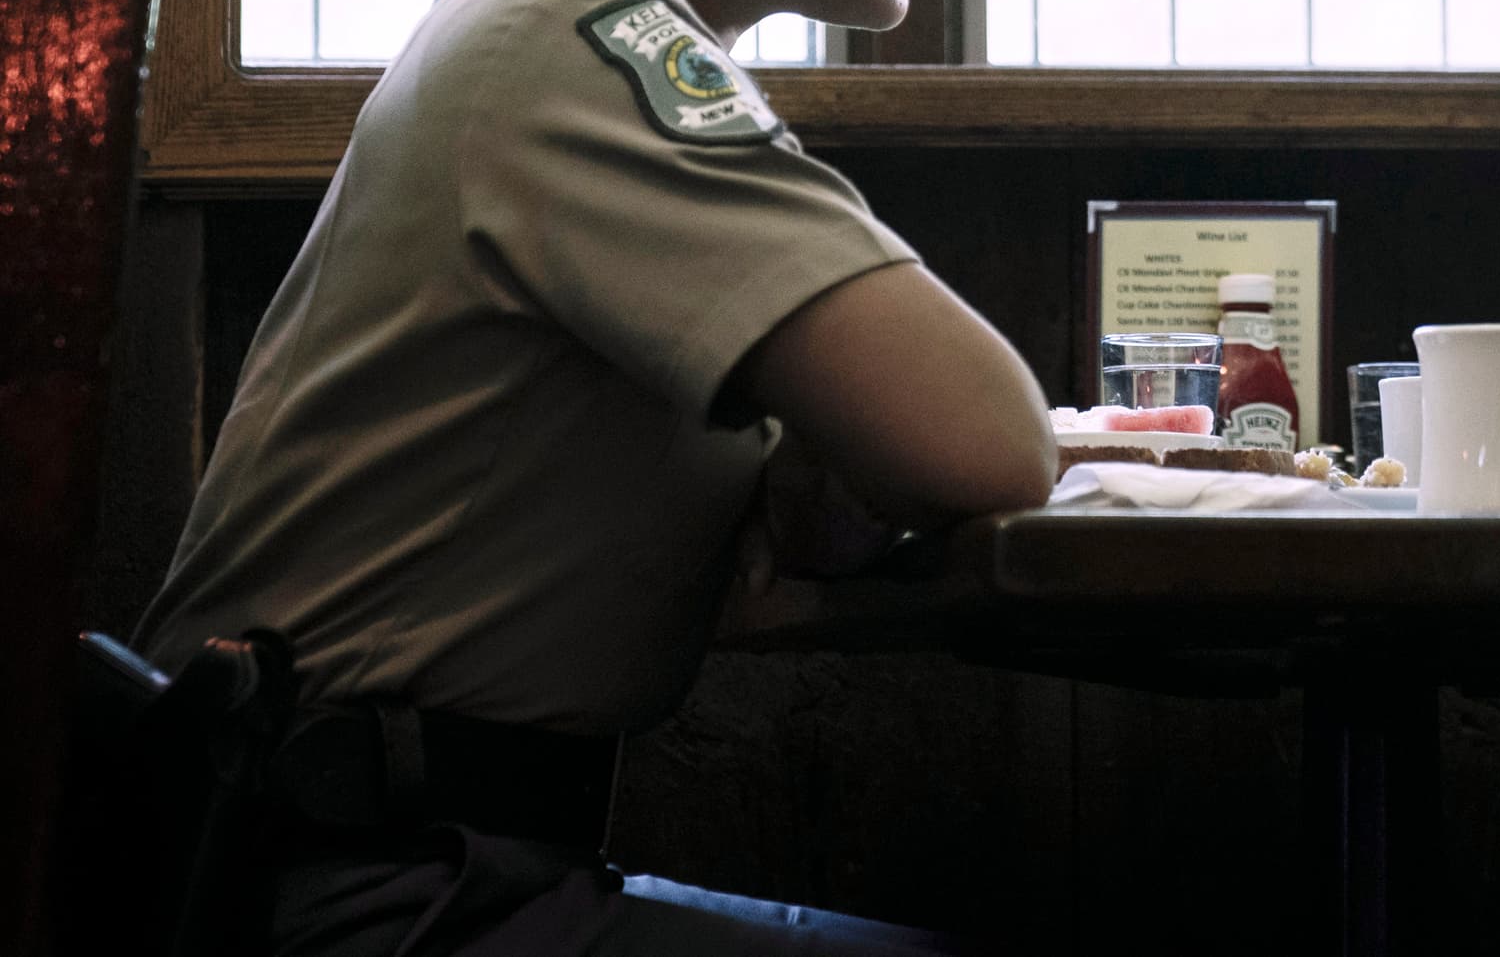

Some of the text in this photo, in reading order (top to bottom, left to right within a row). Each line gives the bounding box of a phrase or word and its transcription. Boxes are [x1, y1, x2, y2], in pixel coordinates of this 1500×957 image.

[700, 103, 735, 123] NEW
[1196, 231, 1247, 242] Wine List
[1117, 301, 1134, 311] Cup
[1137, 300, 1159, 309] Cake
[1246, 416, 1281, 431] HEINZ
